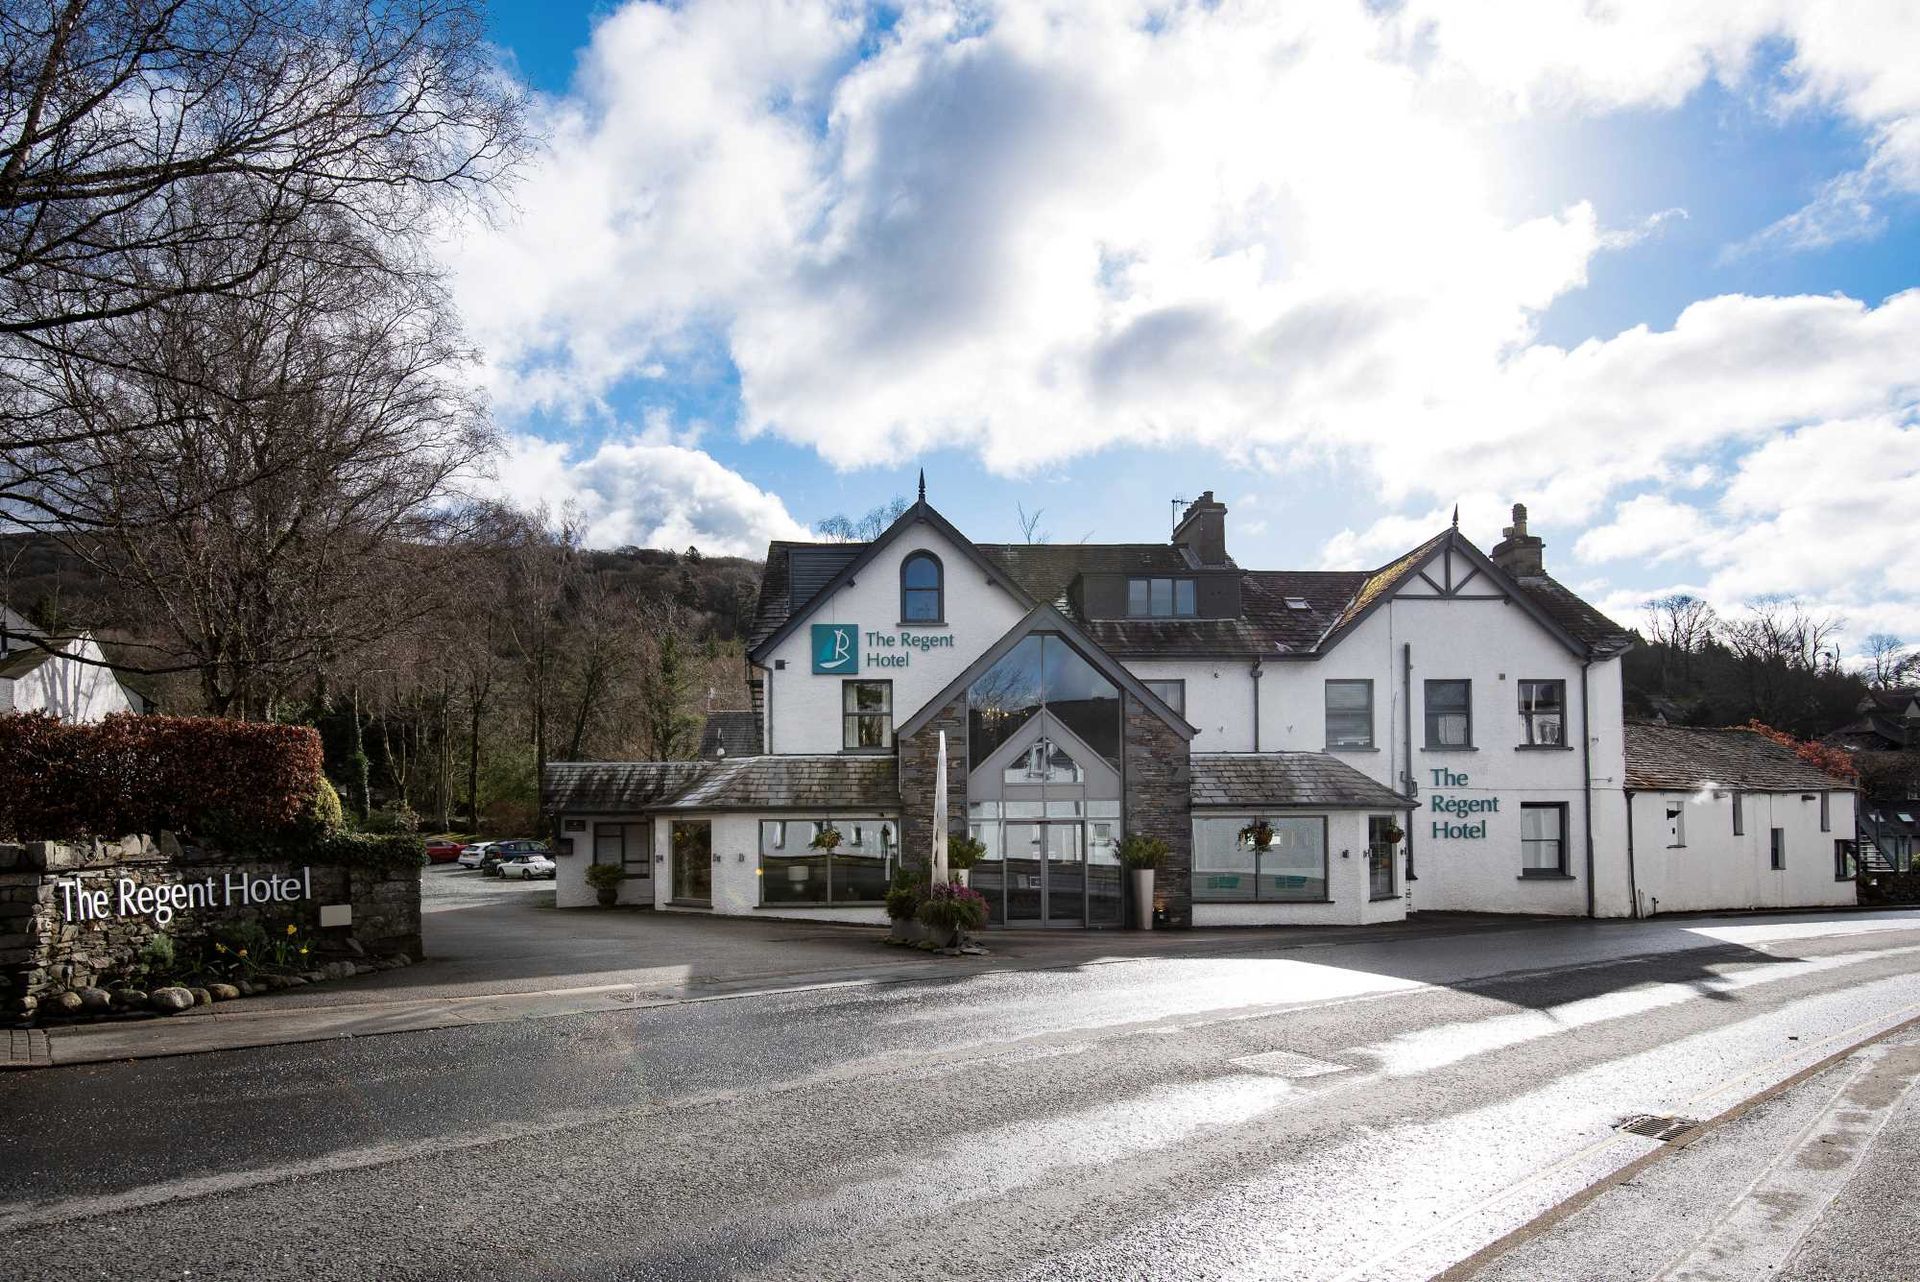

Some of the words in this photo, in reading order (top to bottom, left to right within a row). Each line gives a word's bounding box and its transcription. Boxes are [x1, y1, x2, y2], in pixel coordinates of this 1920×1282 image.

[866, 631, 895, 647] The
[901, 632, 953, 650] Regent
[867, 652, 909, 667] Hotel
[1429, 767, 1469, 786] The
[1431, 795, 1500, 818] Regent
[1432, 820, 1486, 839] Hotel
[58, 877, 109, 922] The
[118, 876, 217, 924] Regent
[224, 866, 312, 906] Hotel
